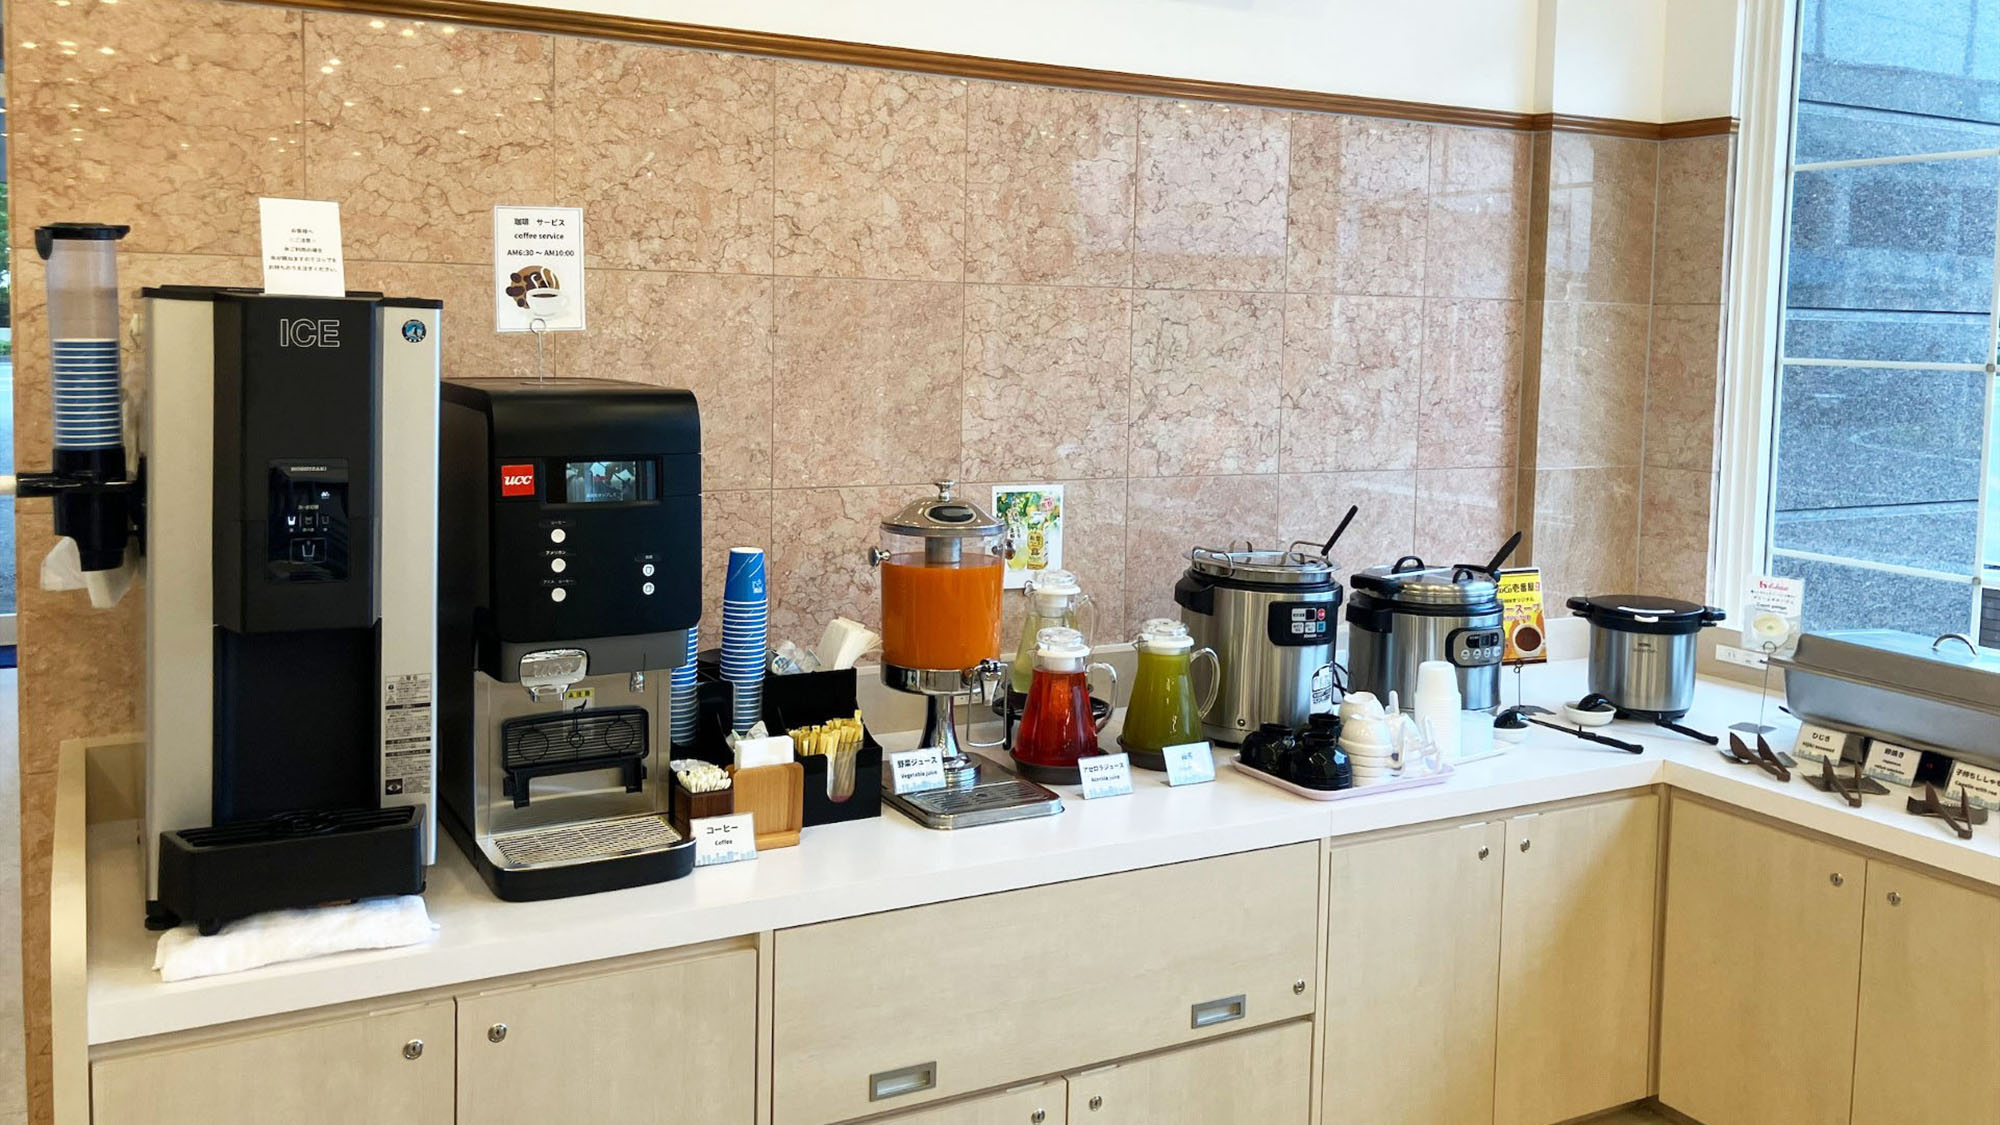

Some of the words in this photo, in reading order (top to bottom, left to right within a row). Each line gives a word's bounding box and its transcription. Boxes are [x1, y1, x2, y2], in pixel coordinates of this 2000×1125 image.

[513, 217, 530, 226] 珈琲
[536, 218, 566, 227] サービス
[513, 231, 538, 240] coffee
[538, 232, 565, 240] service
[506, 249, 535, 257] AM6:30
[543, 249, 575, 257] AM10:00
[279, 318, 341, 348] ICE
[1812, 732, 1830, 743] ひじき
[897, 756, 938, 769] 野菜ジュース
[1083, 762, 1125, 773] アセロラジュース
[706, 824, 739, 835] コーヒー
